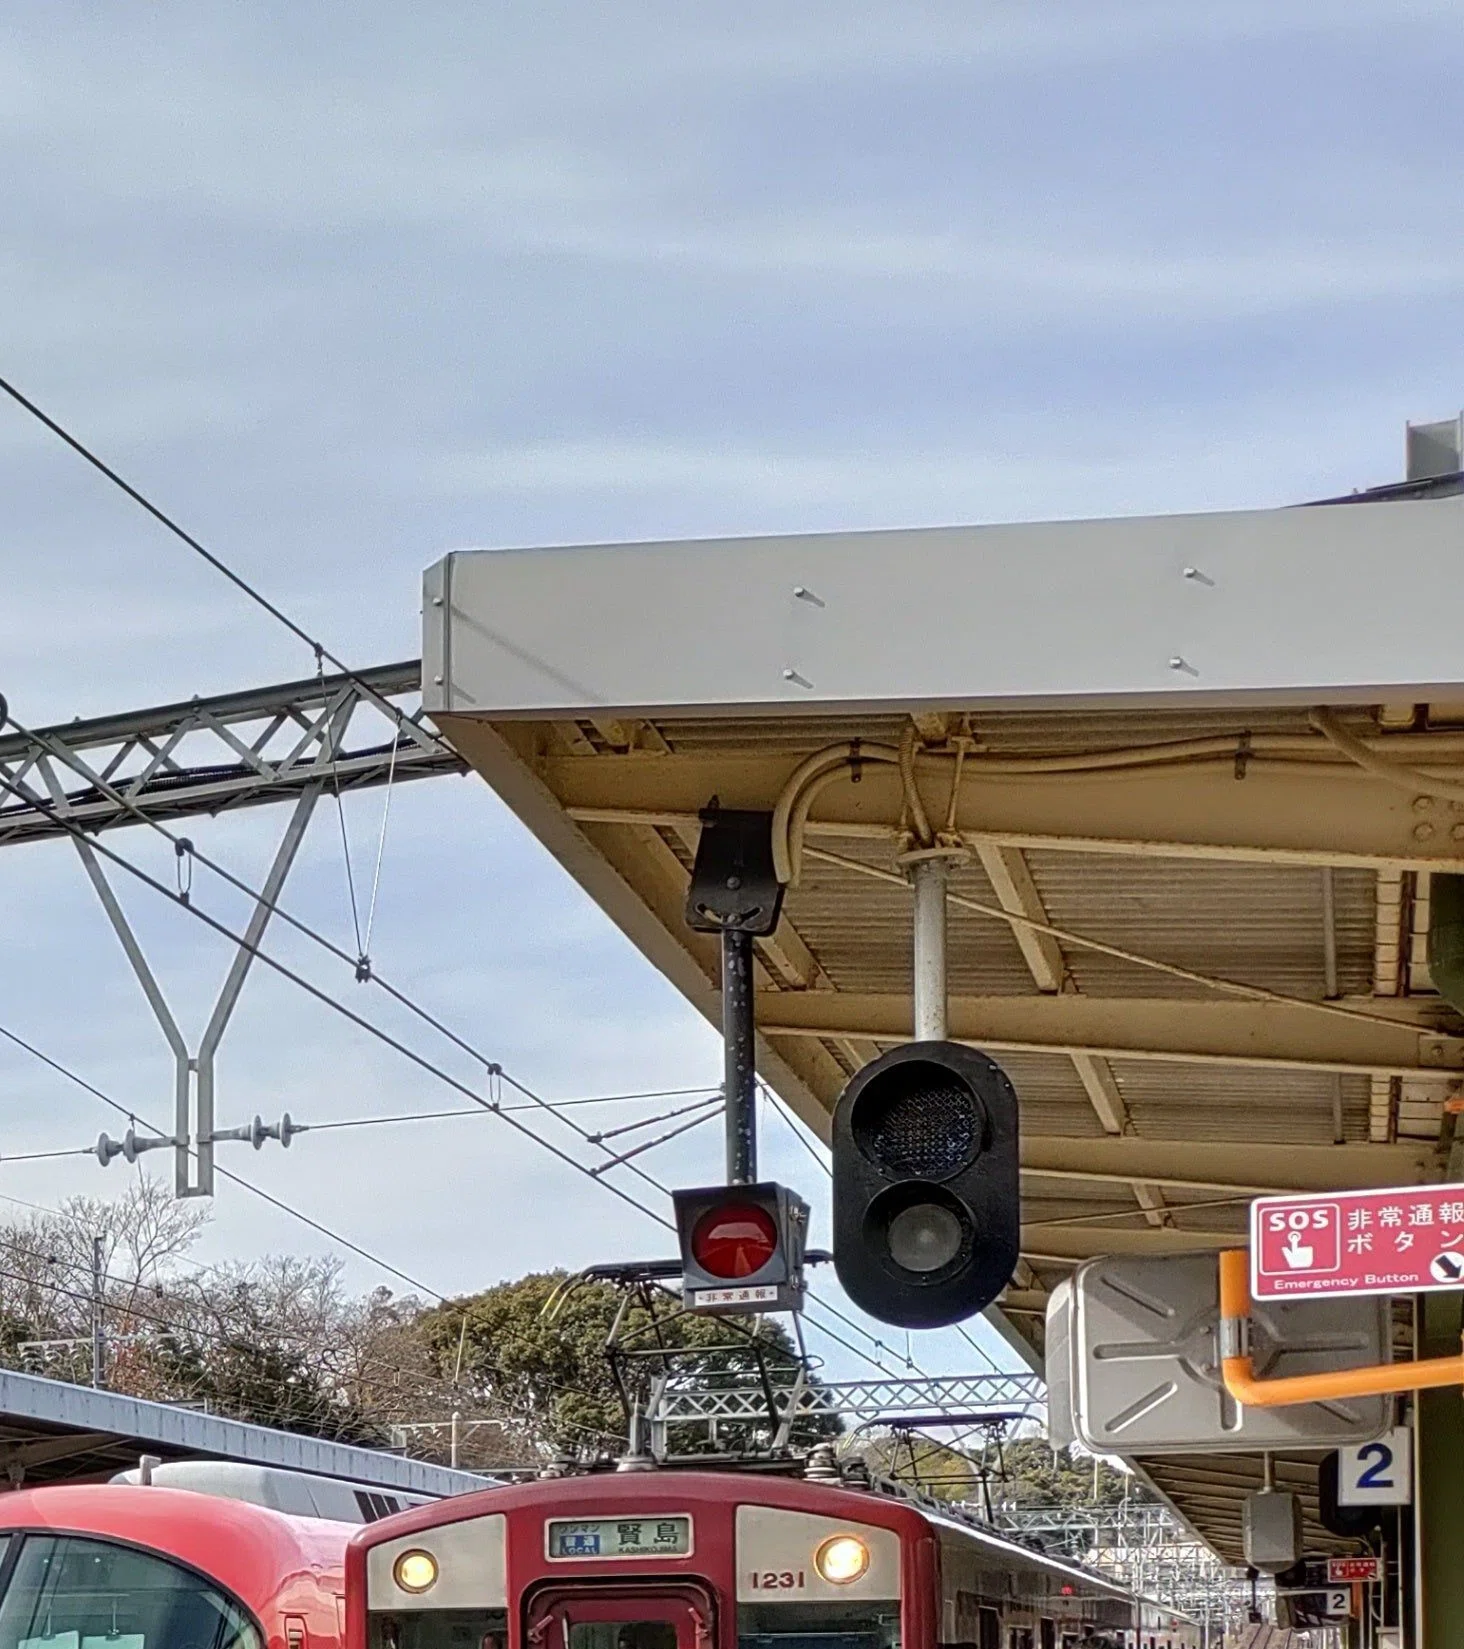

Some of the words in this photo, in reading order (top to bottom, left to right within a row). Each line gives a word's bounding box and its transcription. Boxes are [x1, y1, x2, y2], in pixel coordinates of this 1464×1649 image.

[1269, 1209, 1329, 1232] SOS
[1347, 1202, 1464, 1231] 非常通報
[1347, 1230, 1464, 1255] ボタン
[1273, 1276, 1359, 1290] Emergency
[1364, 1272, 1419, 1285] Button
[1356, 1442, 1394, 1489] 2
[617, 1522, 680, 1545] 賢島
[752, 1571, 805, 1589] 1231
[1333, 1593, 1346, 1609] 2
